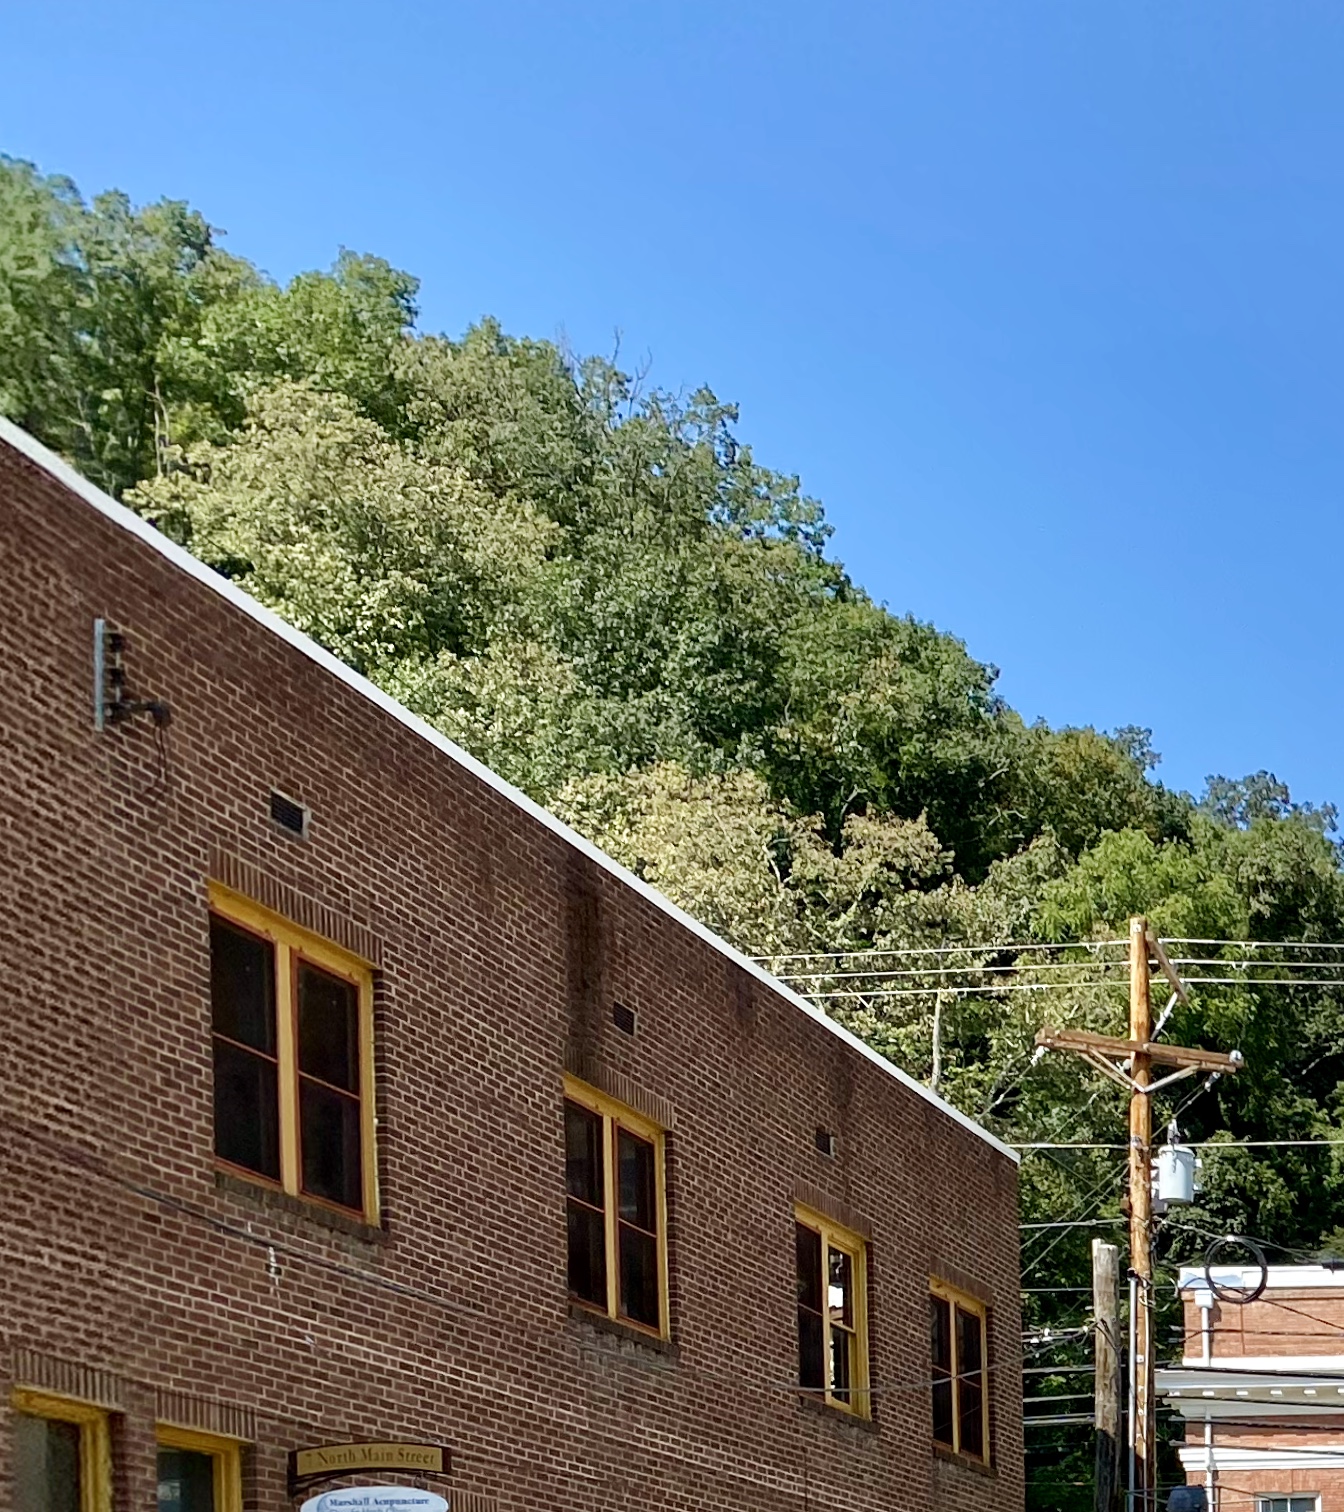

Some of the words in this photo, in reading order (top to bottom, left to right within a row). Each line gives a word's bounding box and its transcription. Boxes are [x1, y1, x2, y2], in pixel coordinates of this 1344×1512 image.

[317, 1449, 356, 1466] North
[361, 1447, 394, 1462] Main
[398, 1448, 435, 1464] Street
[329, 1497, 370, 1507] Marshall
[373, 1497, 430, 1508] Acupuncture
